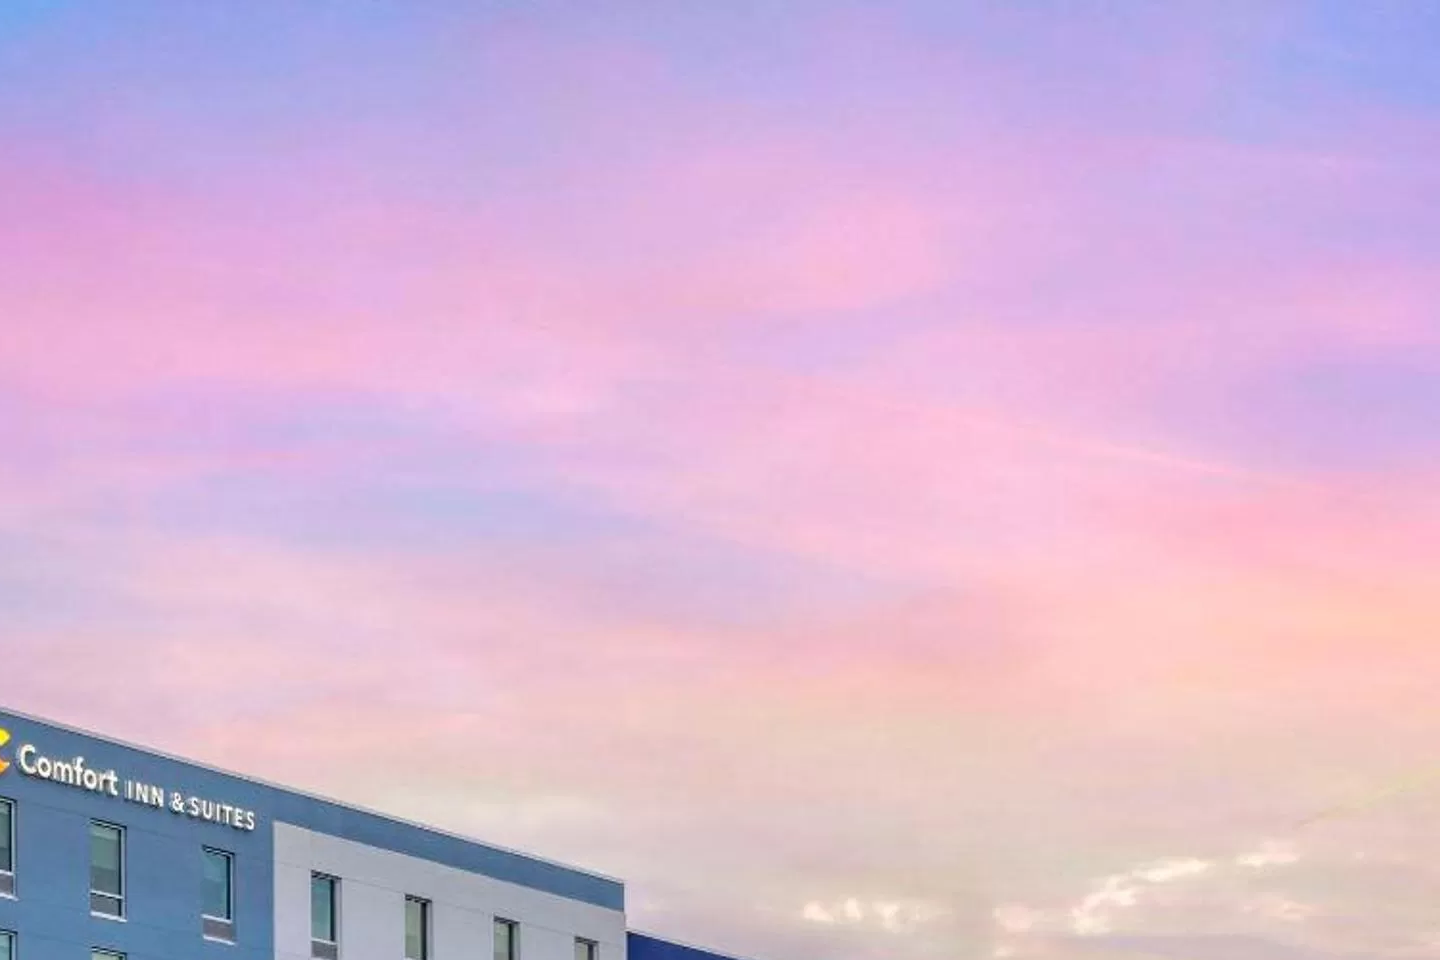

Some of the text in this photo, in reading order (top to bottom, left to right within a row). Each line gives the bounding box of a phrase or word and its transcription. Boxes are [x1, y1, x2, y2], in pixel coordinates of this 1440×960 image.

[17, 743, 118, 796] Comfort
[124, 780, 164, 807] INN
[188, 797, 255, 830] SUITES
